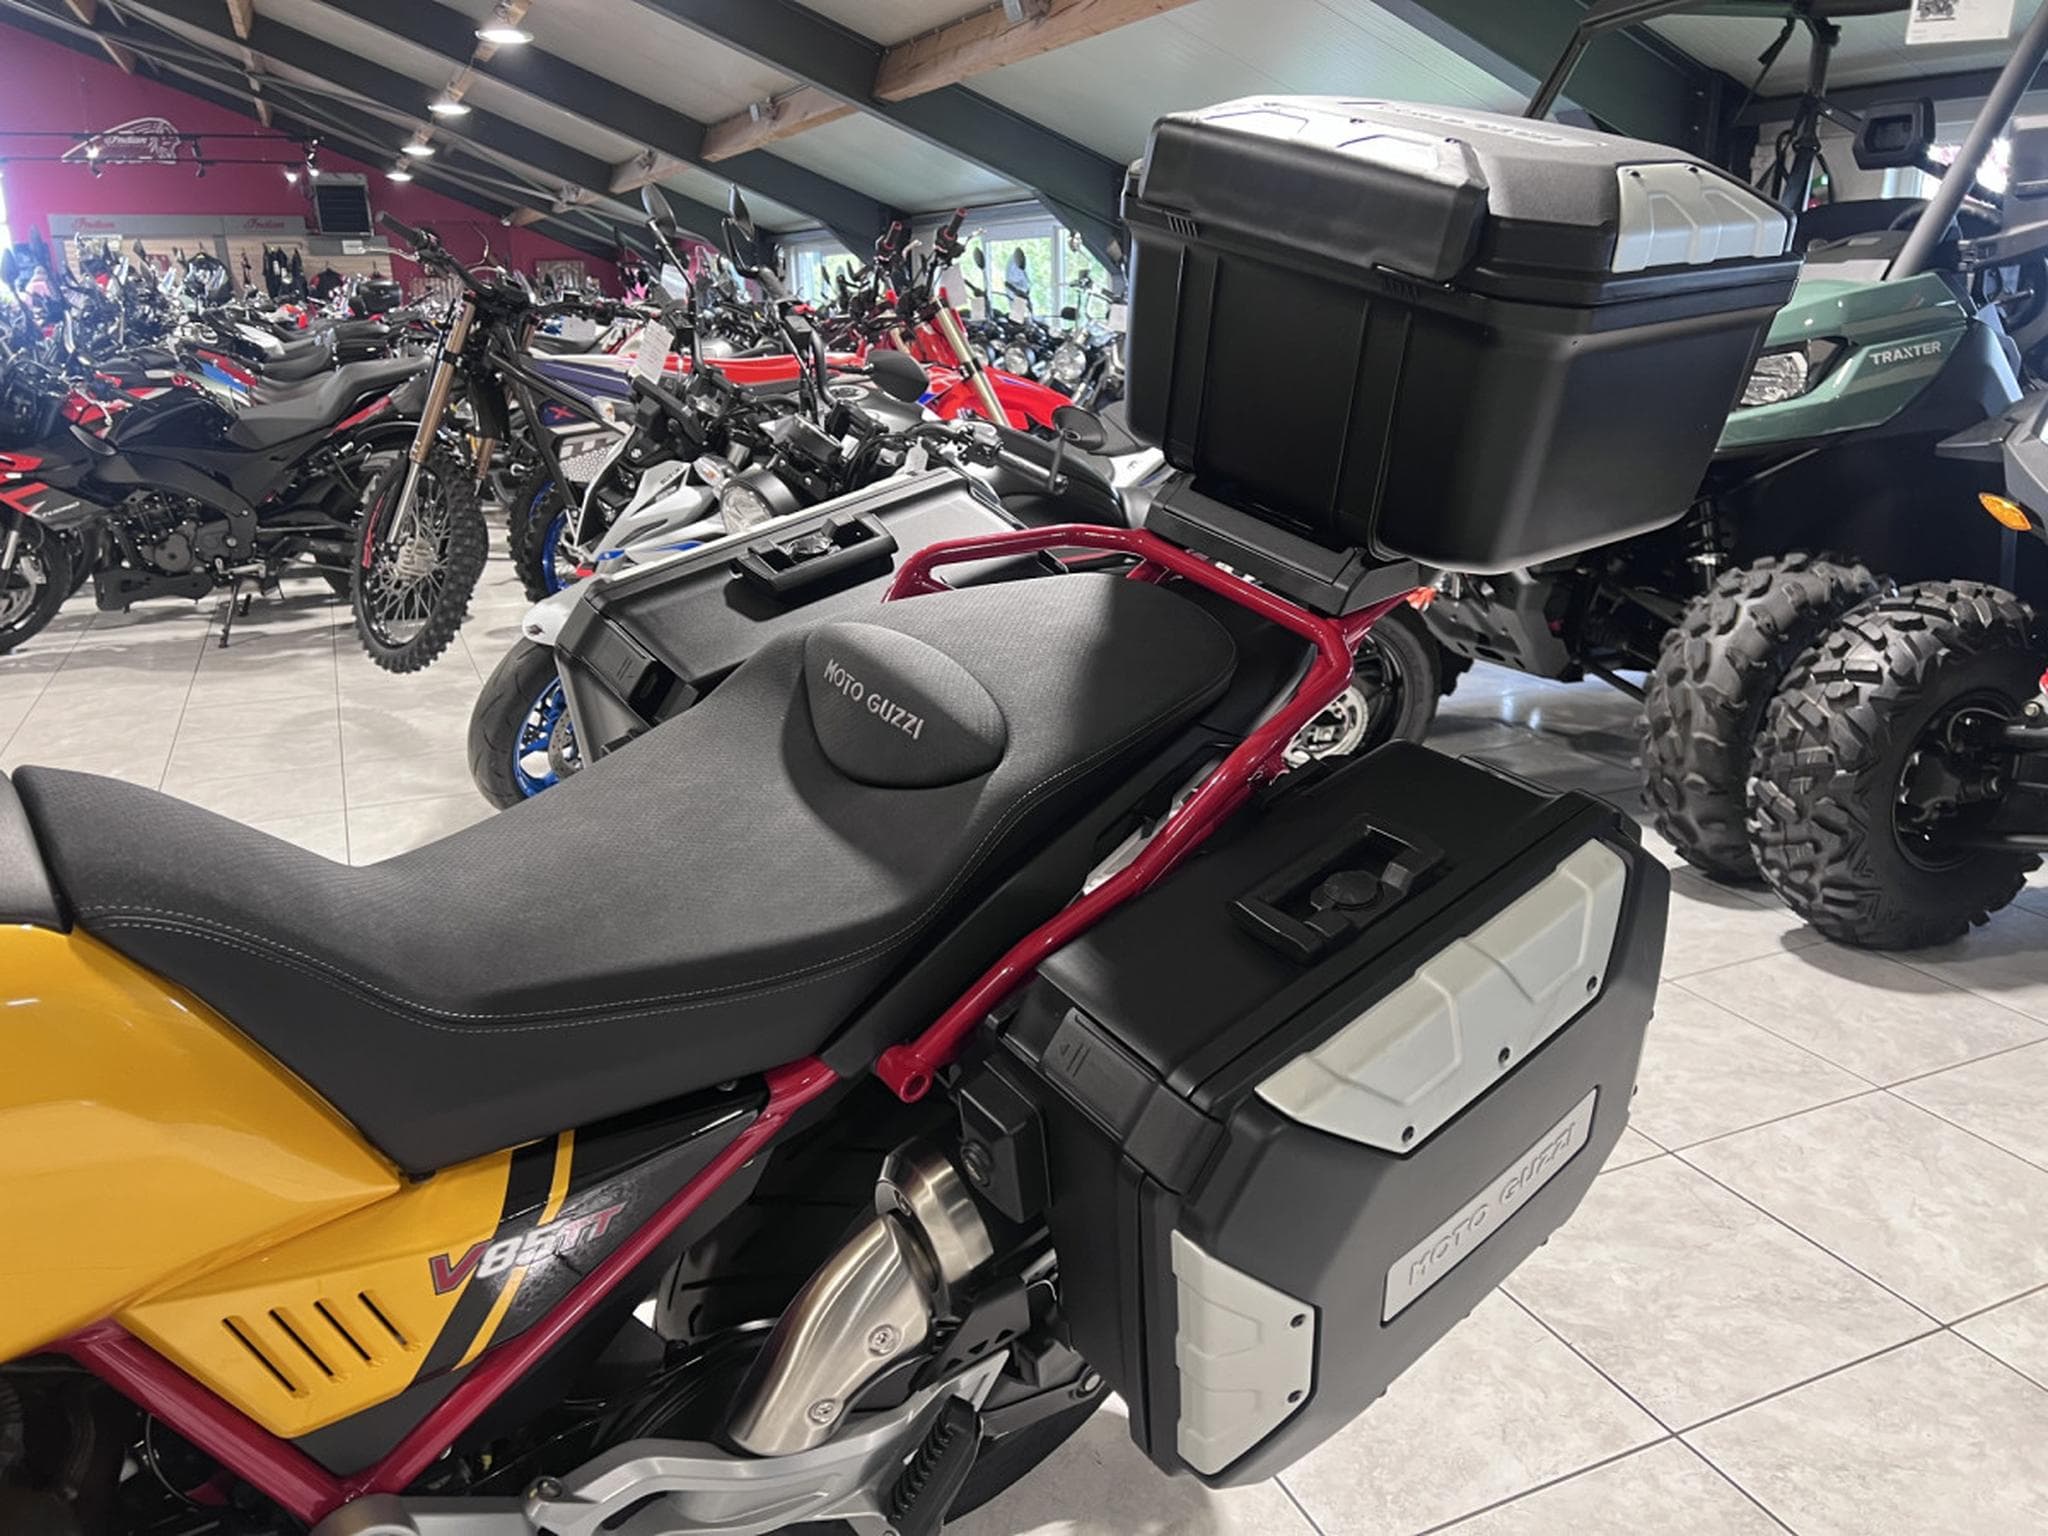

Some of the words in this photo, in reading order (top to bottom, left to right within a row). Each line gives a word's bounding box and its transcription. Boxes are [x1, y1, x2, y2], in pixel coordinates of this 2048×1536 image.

[1868, 341, 1942, 365] TRAXTER
[823, 658, 865, 702] MOTO
[866, 693, 925, 740] GUZZI
[1408, 1203, 1490, 1286] MOTO
[1499, 1121, 1578, 1205] GUZZI
